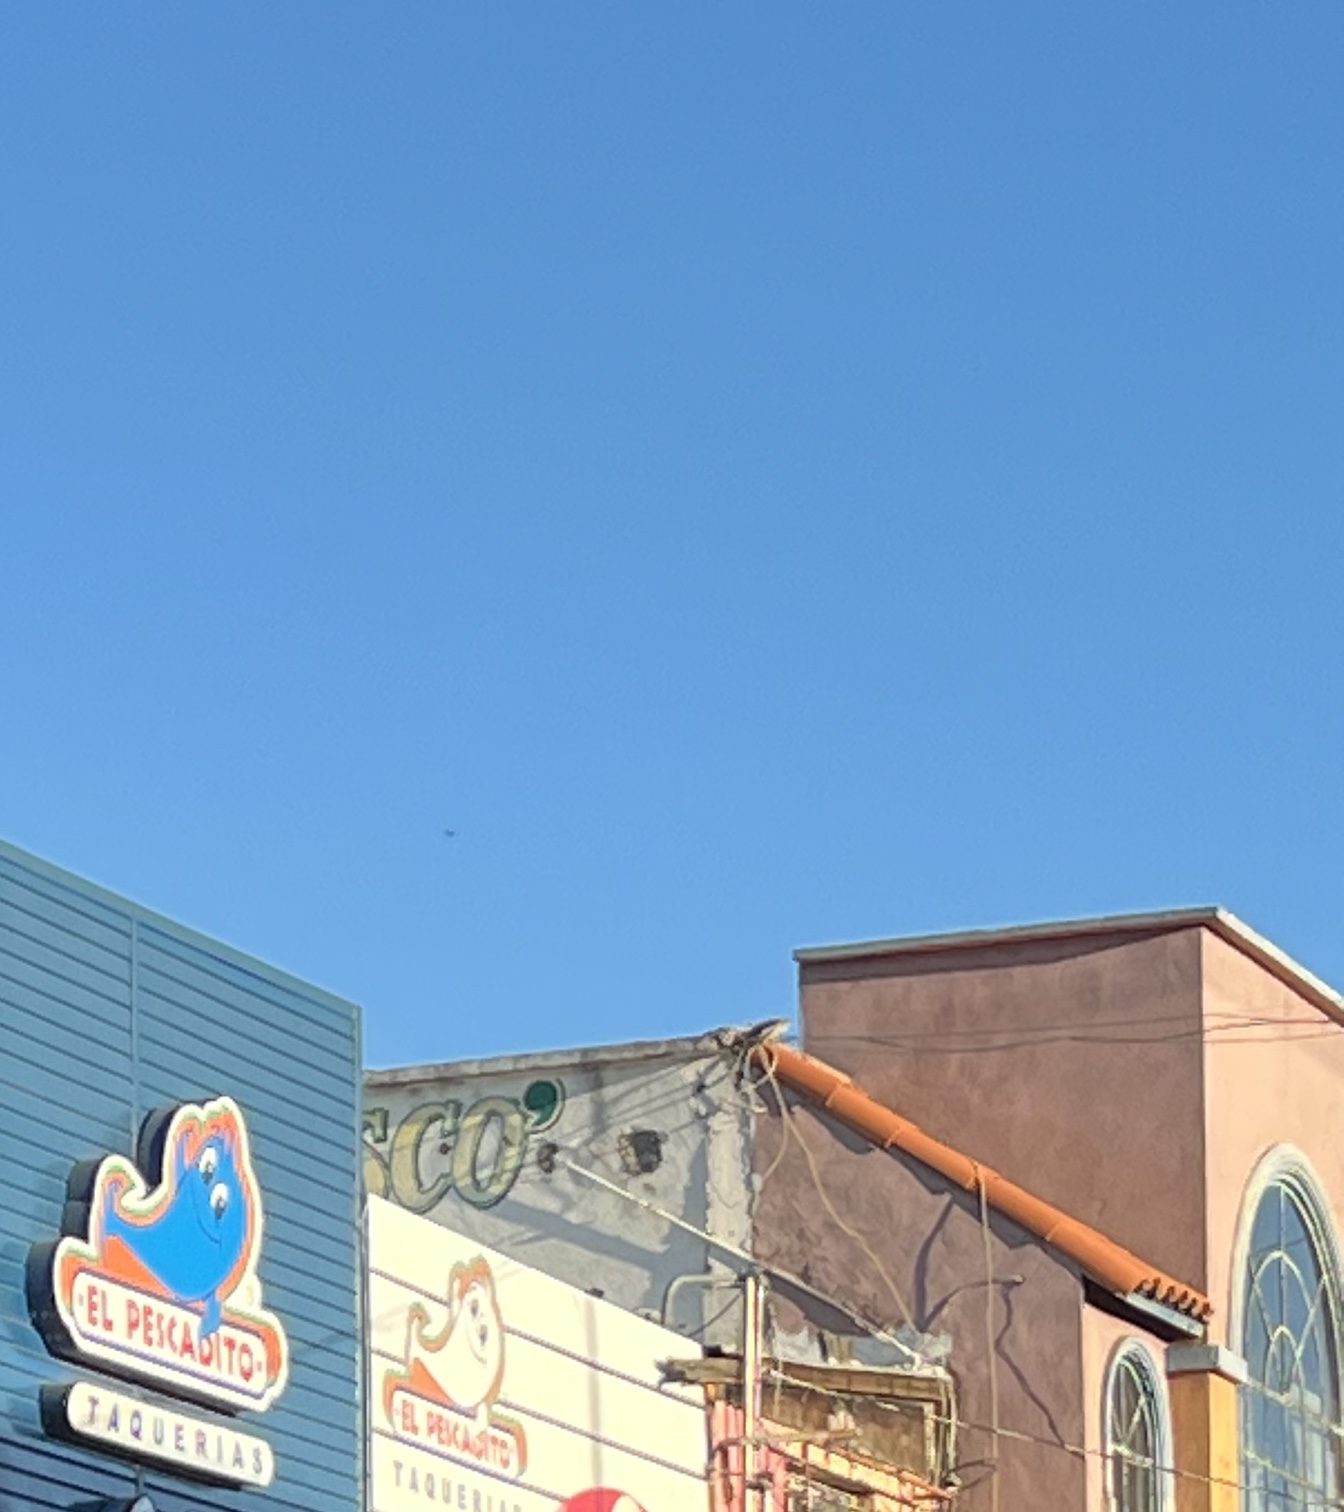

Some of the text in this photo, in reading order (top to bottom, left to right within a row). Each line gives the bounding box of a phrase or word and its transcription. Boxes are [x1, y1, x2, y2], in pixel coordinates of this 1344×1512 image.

[86, 1284, 255, 1382] EL PESCADITO
[87, 1395, 264, 1475] TAQUERIAS
[401, 1398, 511, 1470] EL PESCADITO
